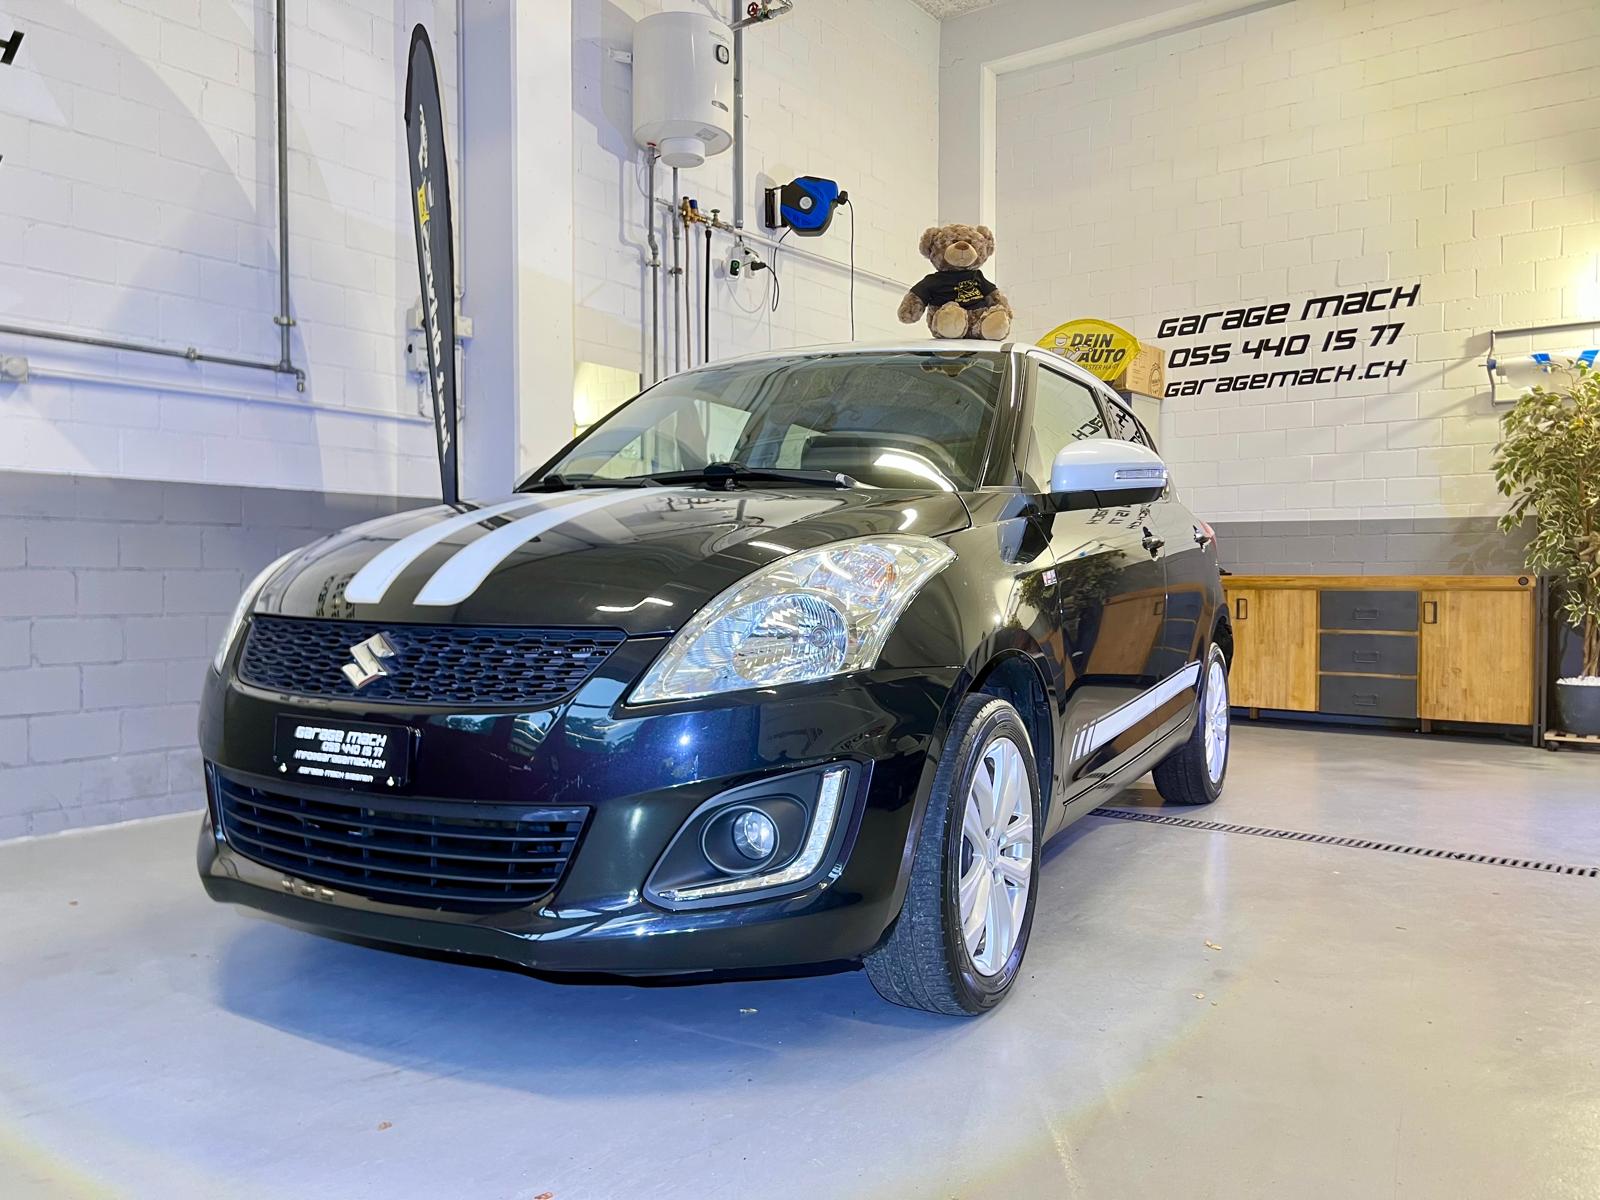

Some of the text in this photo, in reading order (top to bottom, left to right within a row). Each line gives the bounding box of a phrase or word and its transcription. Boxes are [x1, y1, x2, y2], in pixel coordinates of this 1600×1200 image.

[1070, 333, 1114, 347] DEIN
[1168, 342, 1232, 368] 055
[1241, 334, 1311, 359] 440
[1321, 328, 1358, 352] 15
[1369, 322, 1405, 347] 77
[1077, 348, 1126, 363] AUTO
